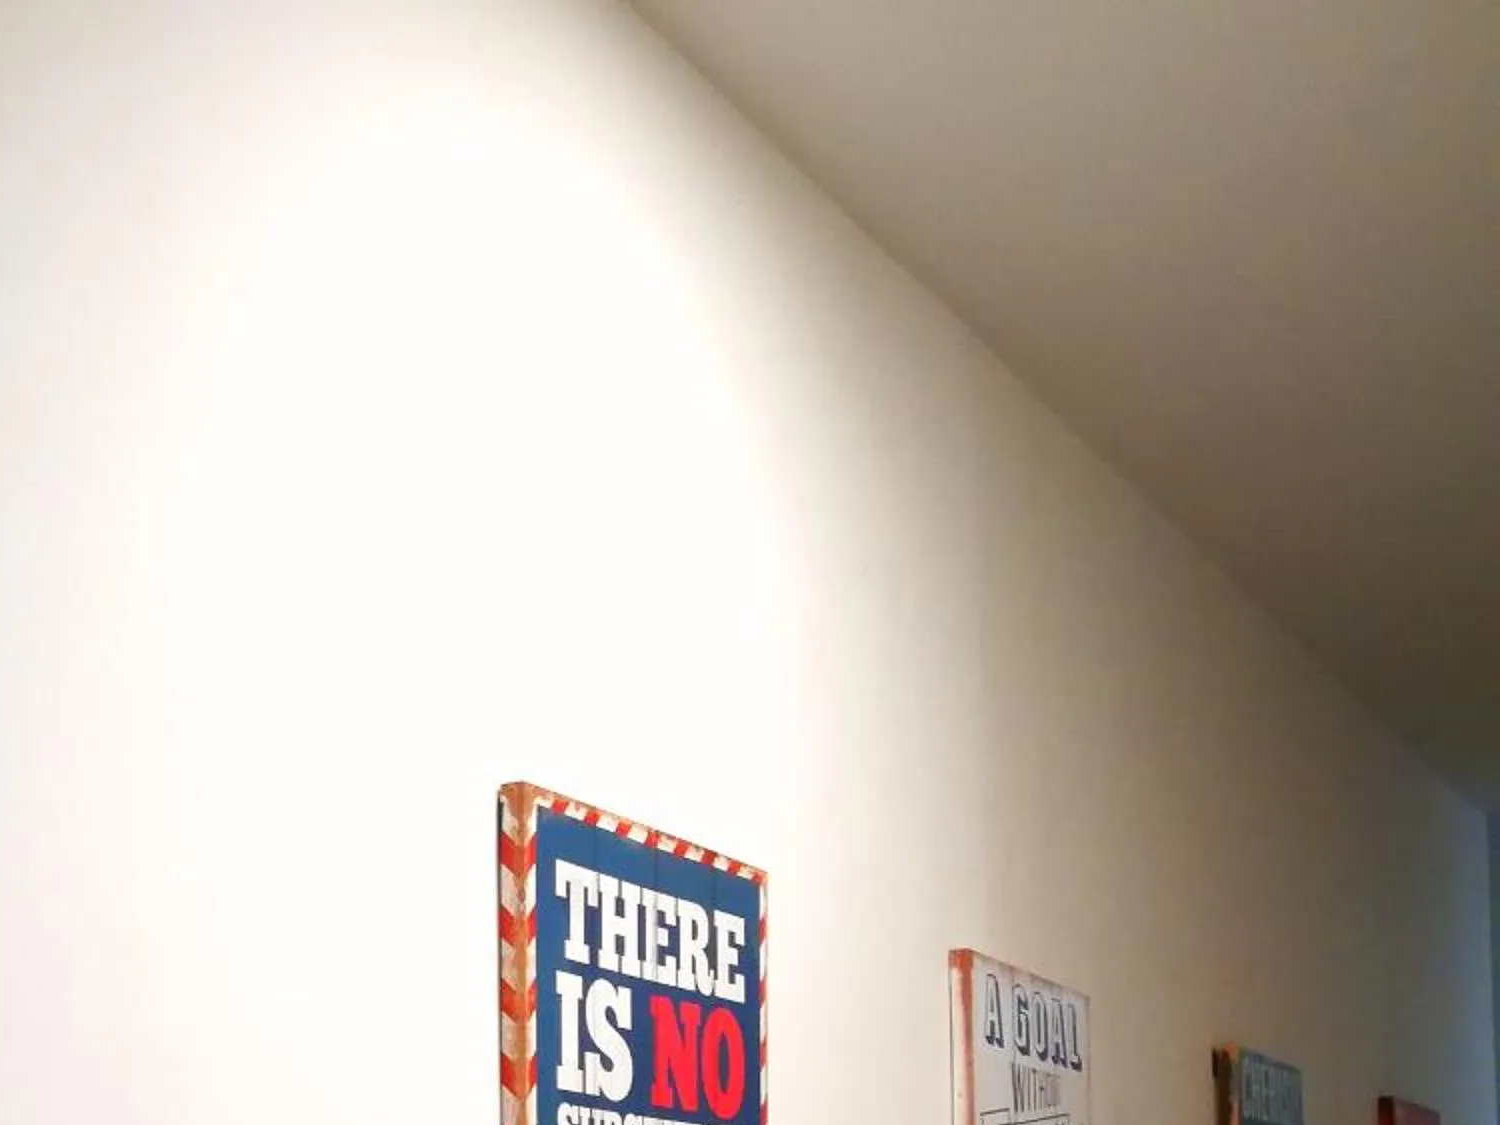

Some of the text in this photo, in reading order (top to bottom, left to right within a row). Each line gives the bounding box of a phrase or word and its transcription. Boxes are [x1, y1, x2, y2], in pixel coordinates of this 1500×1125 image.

[554, 858, 746, 1005] THERE
[555, 971, 746, 1120] IS NO
[985, 973, 1083, 1073] A GOAL
[1011, 1062, 1061, 1114] WITH
